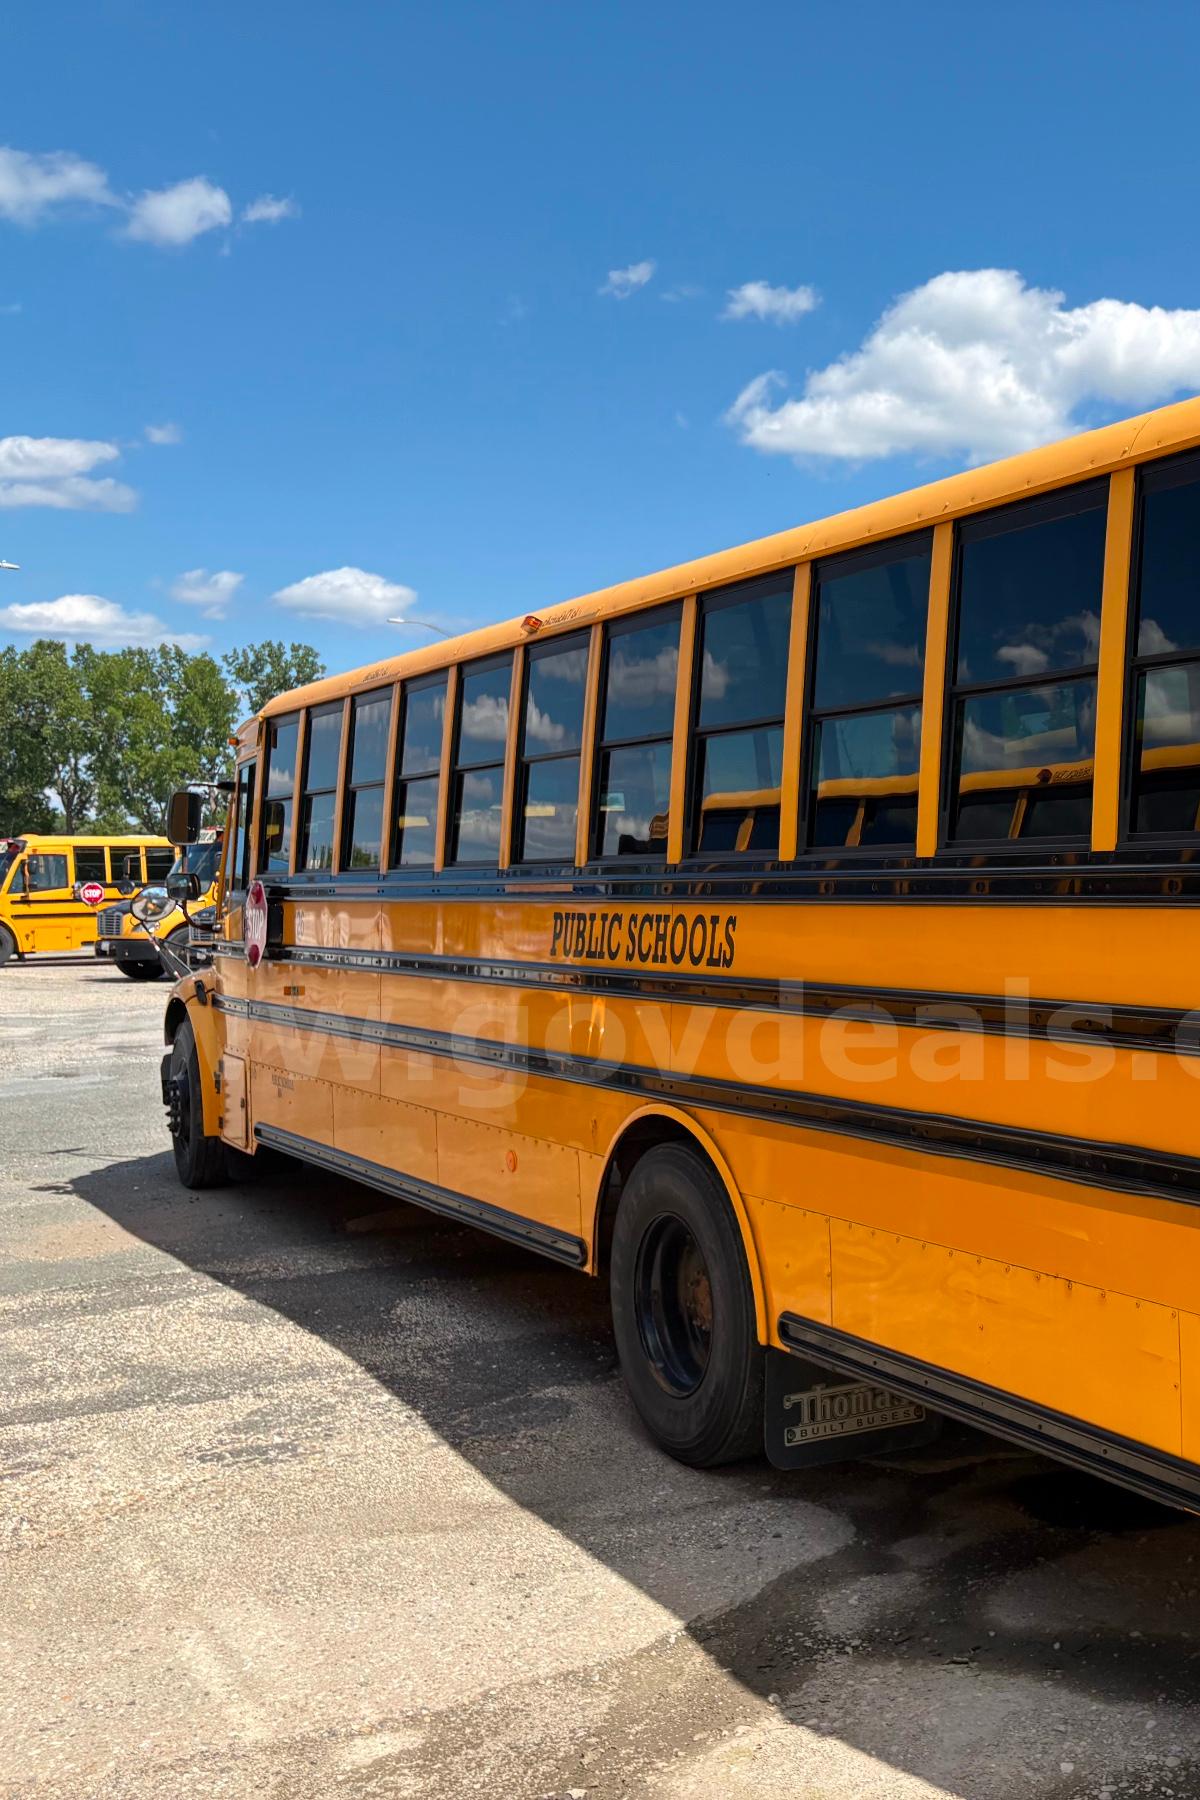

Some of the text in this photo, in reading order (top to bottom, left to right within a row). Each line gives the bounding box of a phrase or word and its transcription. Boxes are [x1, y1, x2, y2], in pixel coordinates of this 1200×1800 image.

[84, 888, 102, 899] STOP
[550, 911, 737, 969] PUBLIC SCHOOLS
[800, 1410, 912, 1438] BUILT BUSES
